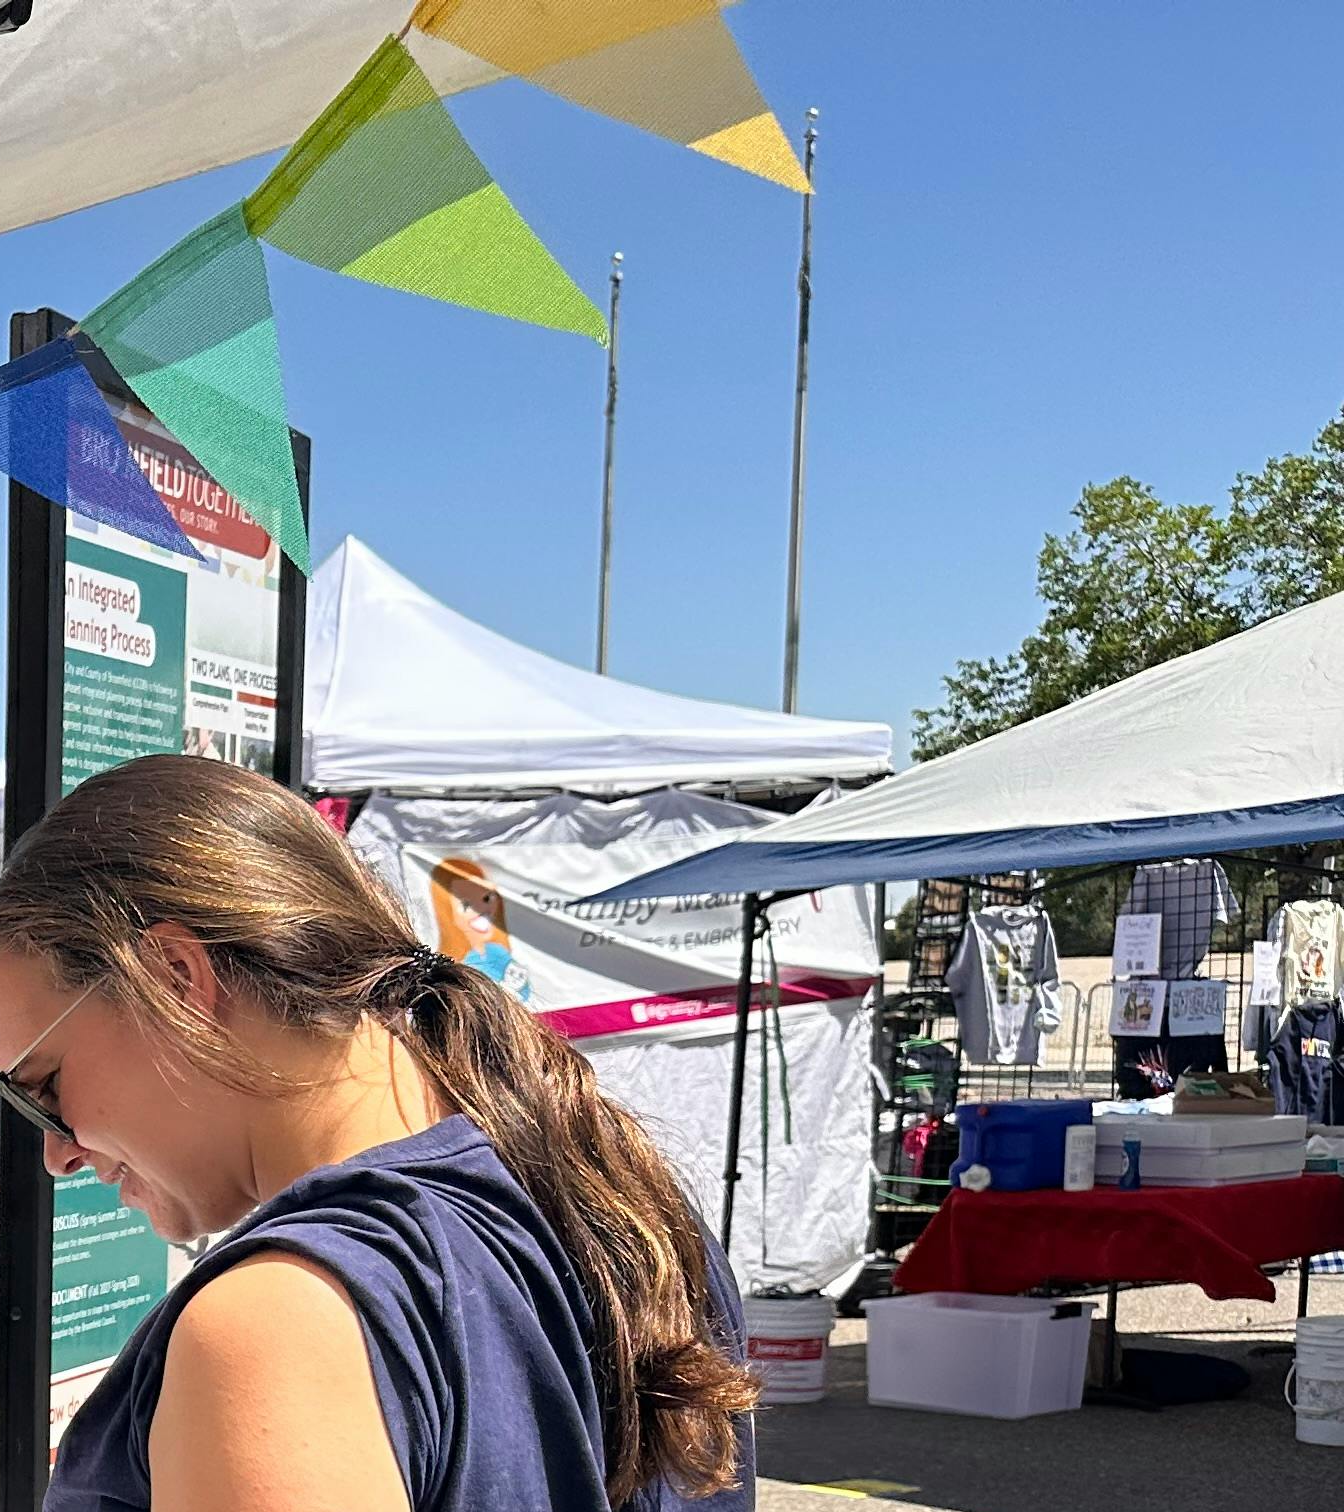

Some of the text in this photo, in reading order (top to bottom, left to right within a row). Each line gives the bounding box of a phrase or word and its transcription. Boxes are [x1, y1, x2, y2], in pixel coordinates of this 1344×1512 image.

[78, 573, 135, 614] Integrated
[66, 613, 151, 658] lanning Process
[192, 658, 208, 677] TWO
[234, 668, 248, 686] ONE
[53, 1212, 80, 1232] DISCUSS
[52, 1284, 88, 1307] DOCUMENT
